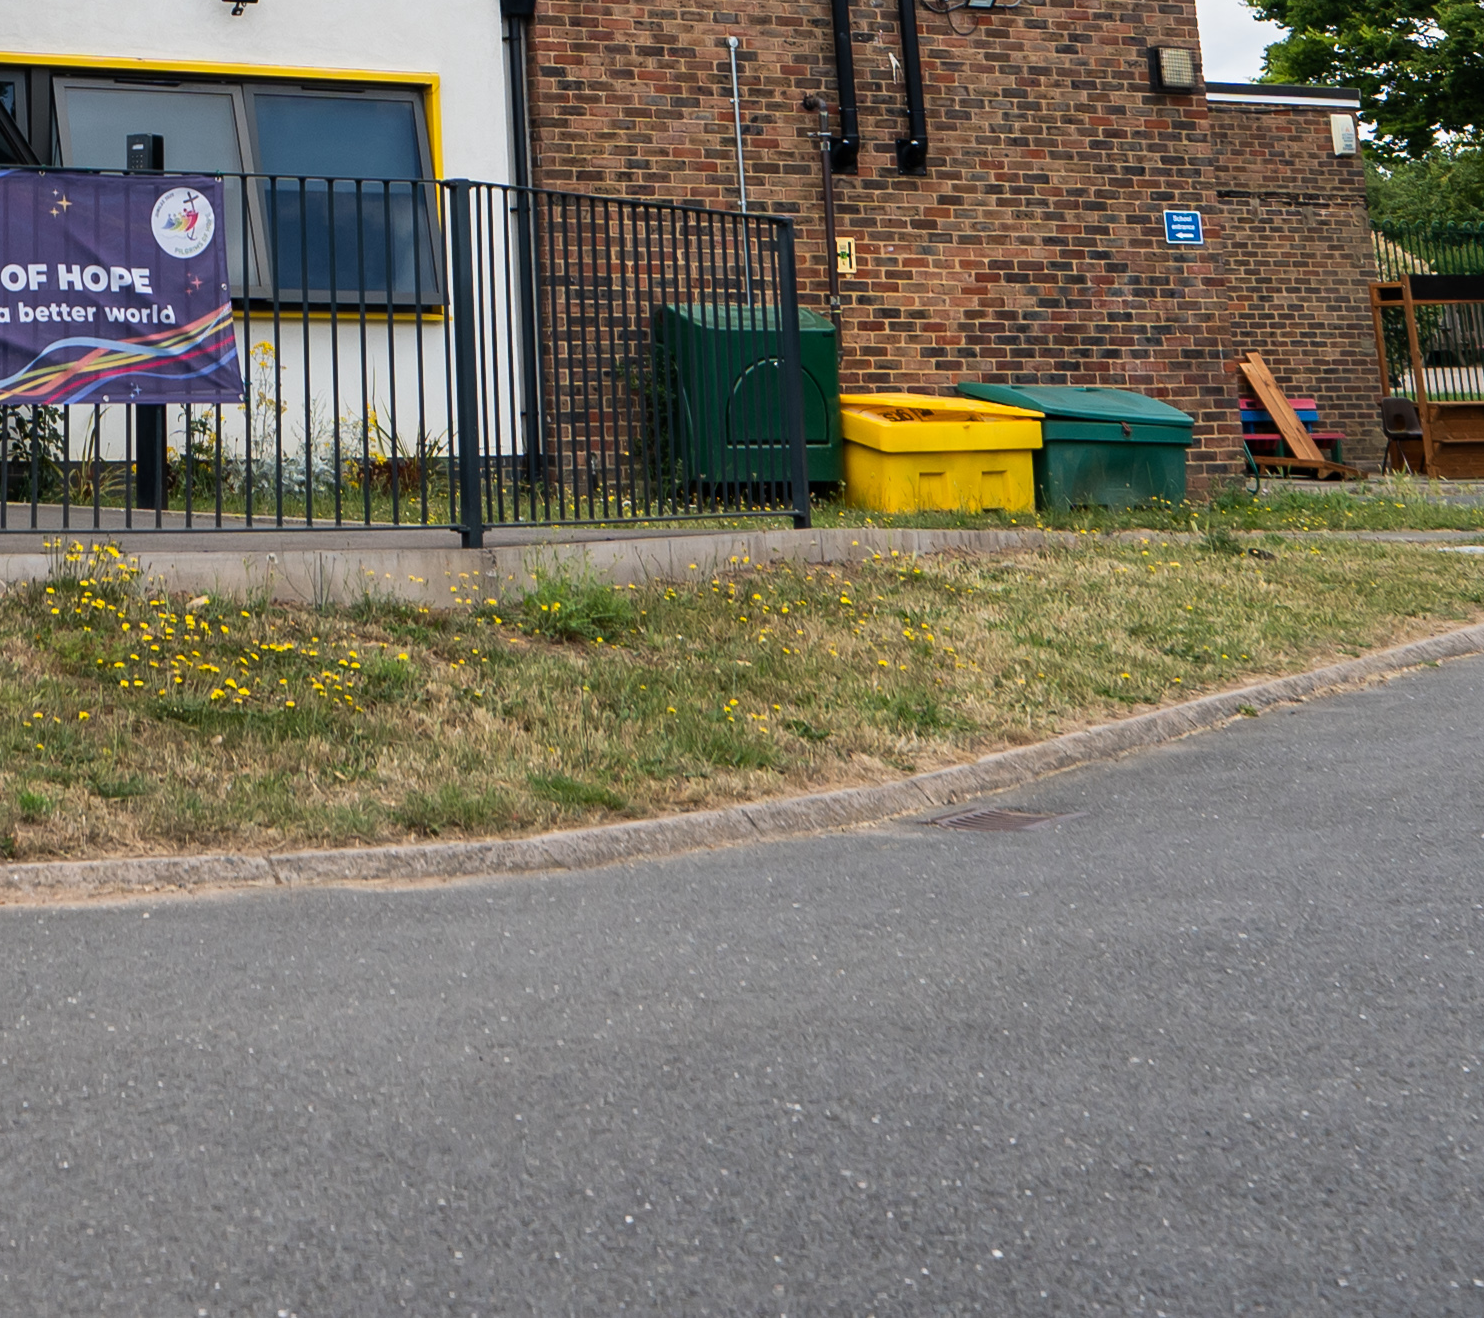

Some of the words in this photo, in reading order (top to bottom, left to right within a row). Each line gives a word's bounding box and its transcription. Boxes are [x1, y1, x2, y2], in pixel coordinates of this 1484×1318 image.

[0, 264, 48, 292] OF
[57, 264, 153, 294] HOPE
[18, 301, 96, 323] better
[104, 304, 176, 325] world
